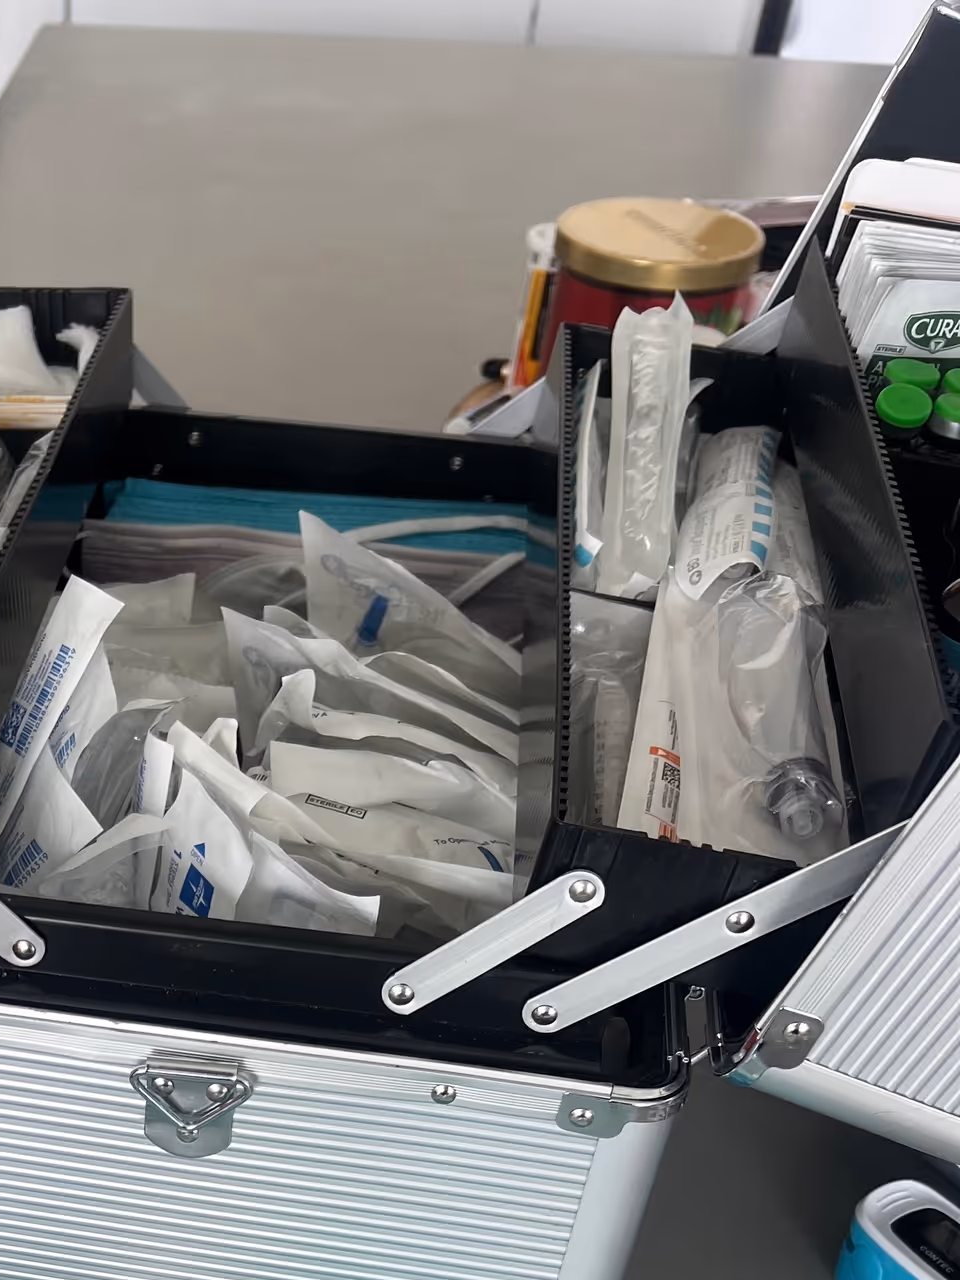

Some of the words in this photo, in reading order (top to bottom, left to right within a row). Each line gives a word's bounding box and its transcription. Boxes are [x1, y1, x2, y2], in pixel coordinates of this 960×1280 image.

[308, 796, 346, 811] STERILE
[349, 808, 363, 816] EO
[920, 1245, 955, 1274] CONTEC
